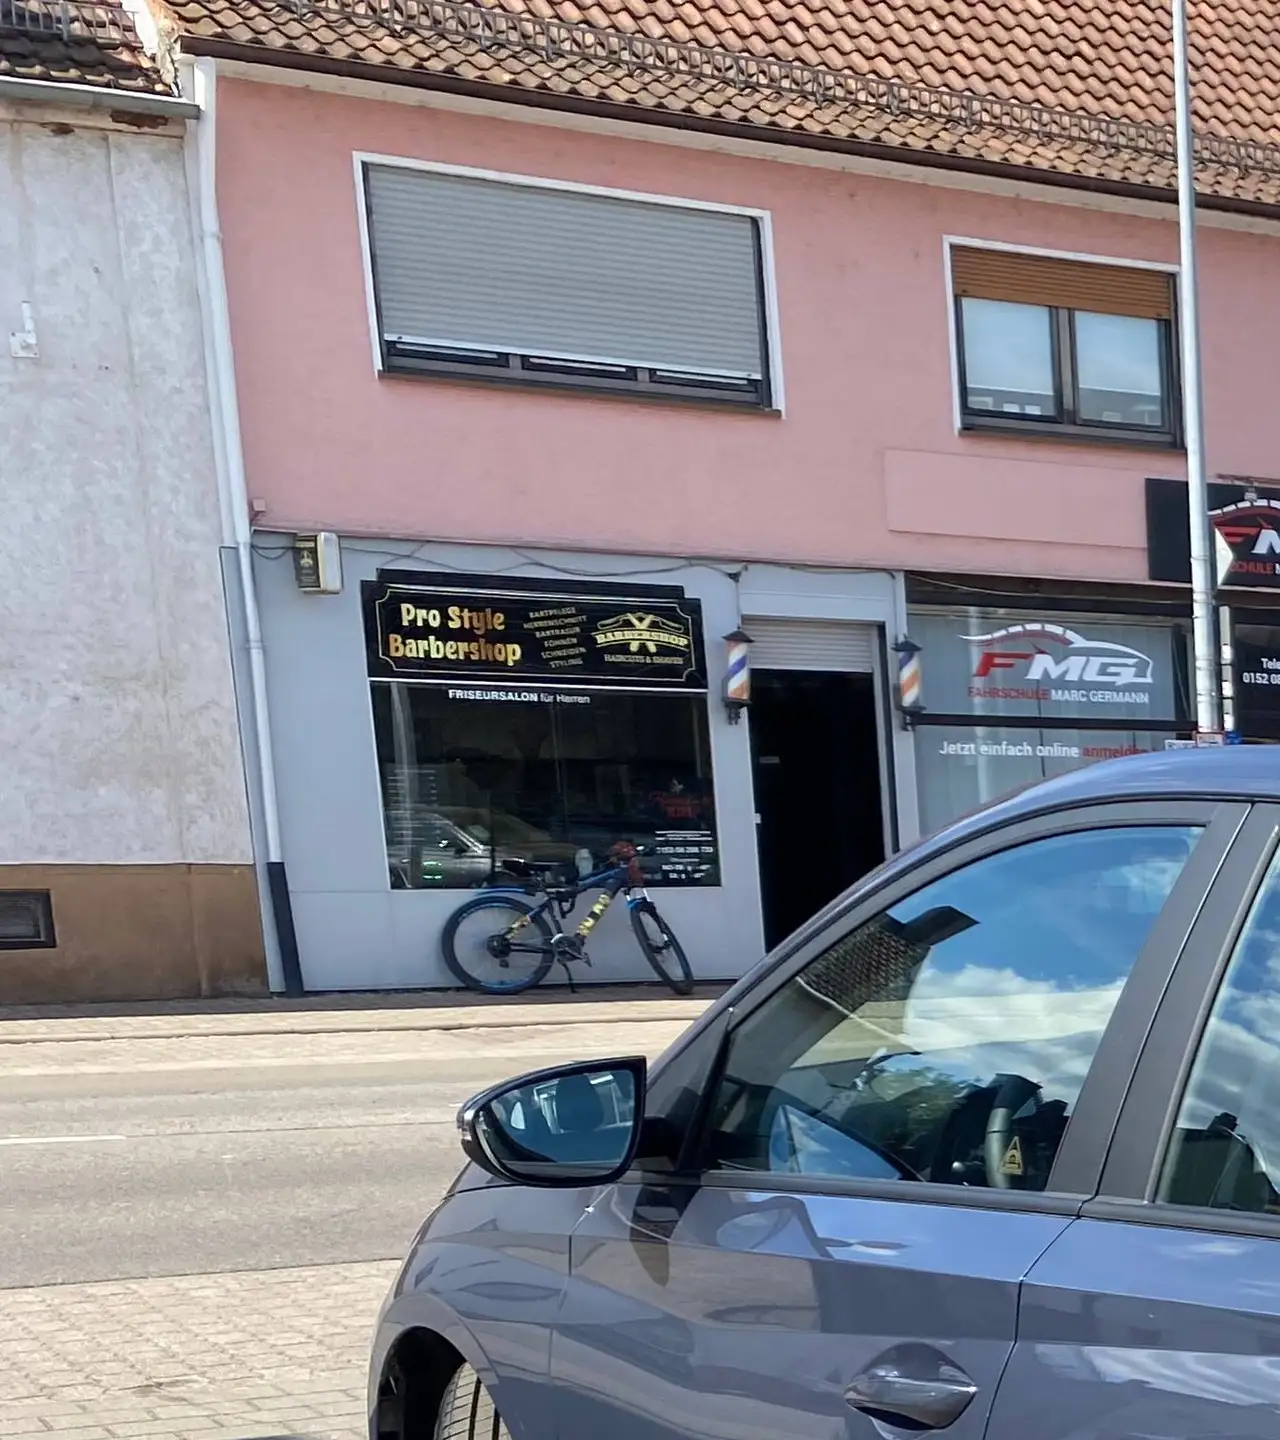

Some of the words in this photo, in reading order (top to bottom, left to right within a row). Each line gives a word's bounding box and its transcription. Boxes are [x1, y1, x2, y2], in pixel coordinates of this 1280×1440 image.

[1230, 561, 1274, 575] SCHULE
[401, 603, 441, 627] Pro
[448, 607, 505, 630] Style
[389, 634, 521, 666] Barbershop
[972, 651, 1145, 686] FMG
[1242, 672, 1270, 684] 0152
[448, 690, 538, 703] FRISEURSALON
[540, 692, 555, 703] für
[556, 693, 591, 704] Herren
[968, 686, 1049, 700] FAHRSCHULE
[1051, 688, 1088, 702] MARC
[1089, 689, 1150, 704] GERMANN
[939, 741, 975, 757] Jetzt
[978, 741, 1034, 758] einfach
[1035, 742, 1080, 758] online
